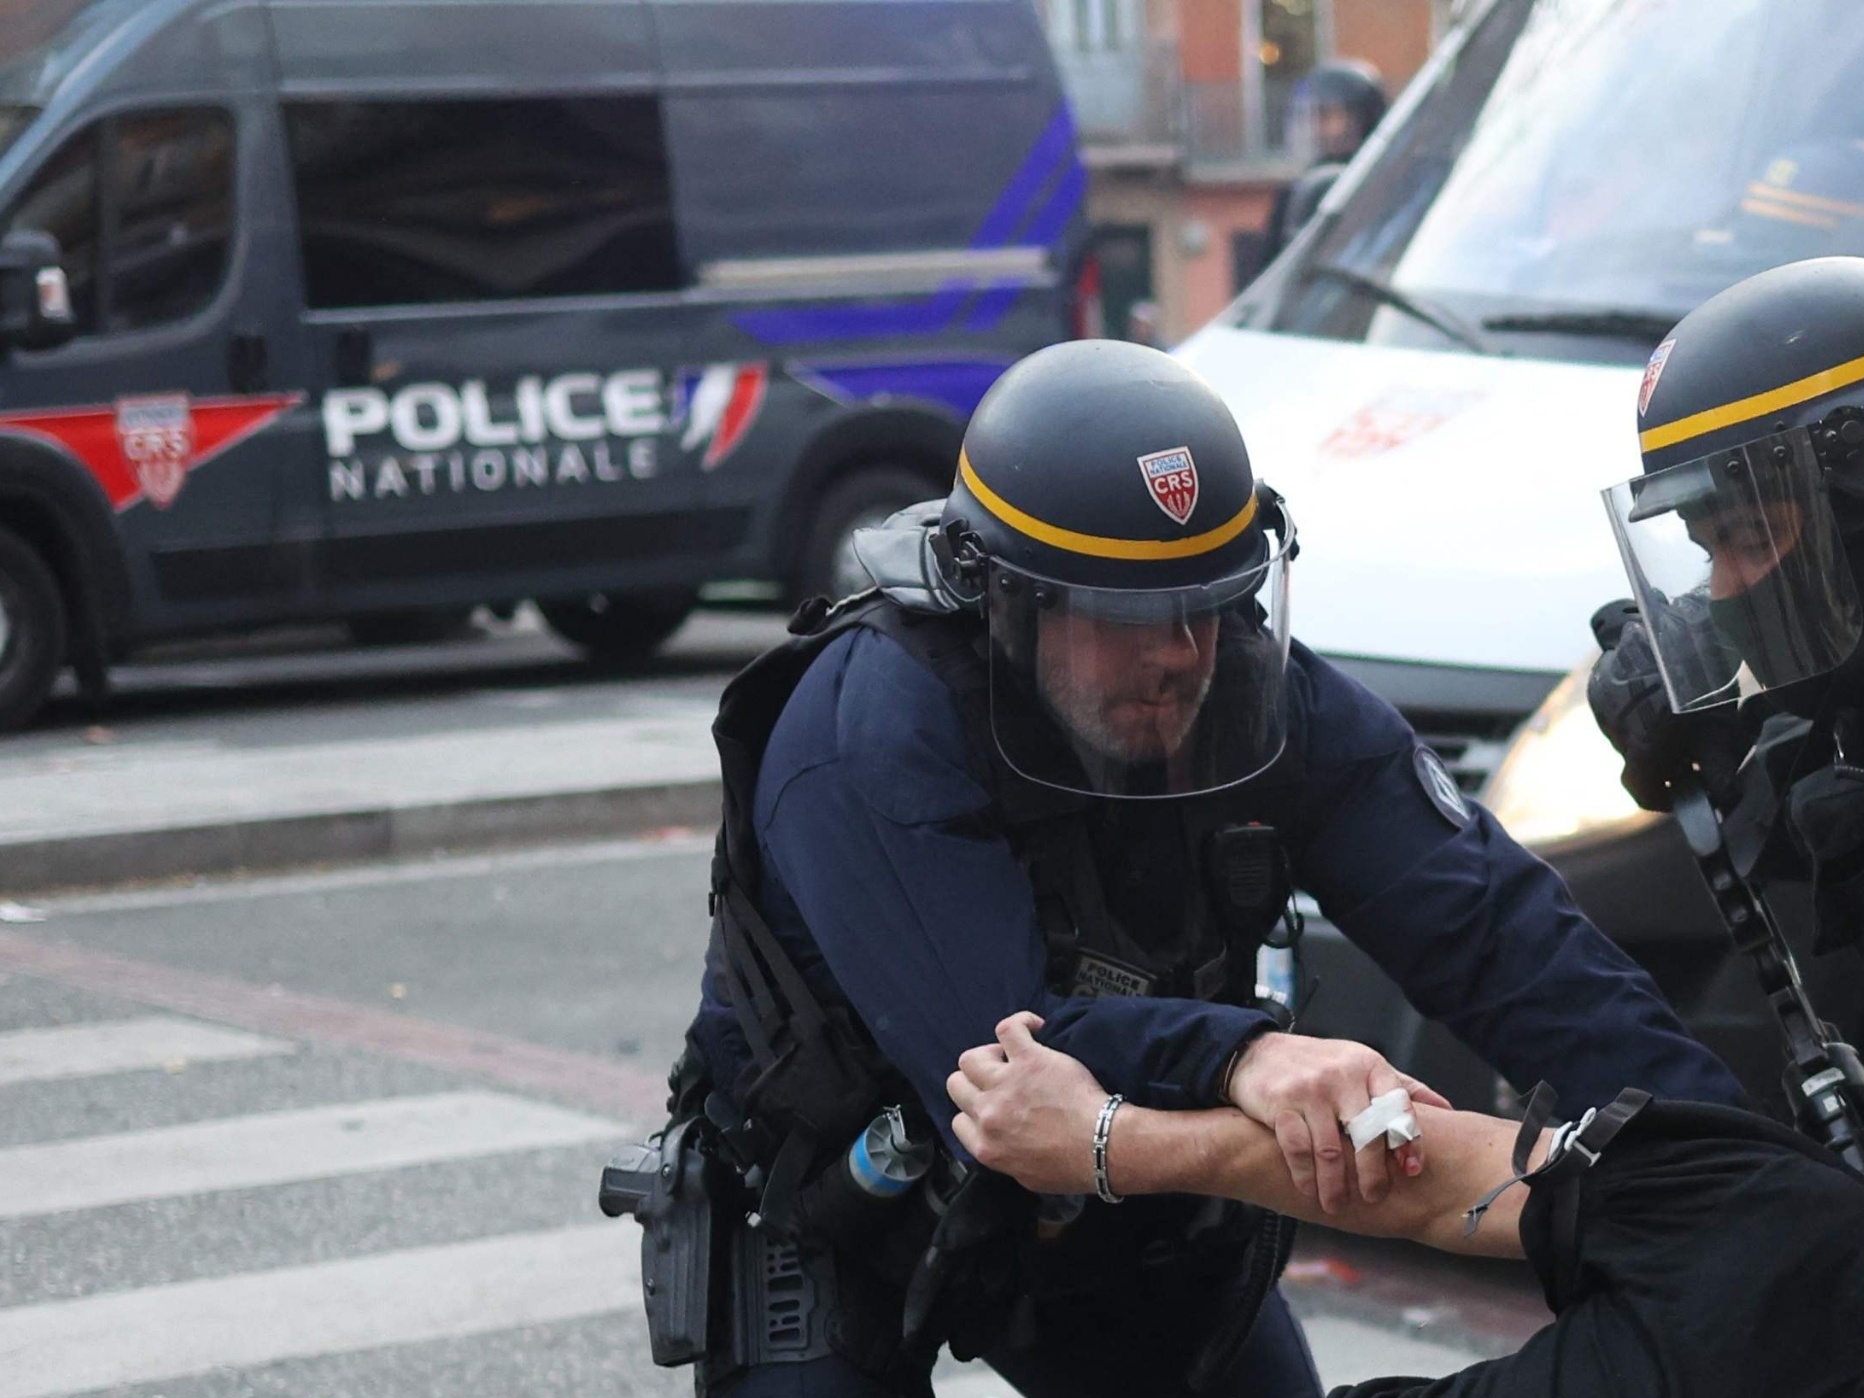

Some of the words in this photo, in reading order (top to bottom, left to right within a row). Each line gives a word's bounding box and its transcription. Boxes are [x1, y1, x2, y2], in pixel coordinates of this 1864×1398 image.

[322, 369, 665, 456] POLICE
[329, 438, 656, 502] NATIONALE
[1154, 471, 1193, 494] CRS
[1086, 961, 1140, 991] POLICE
